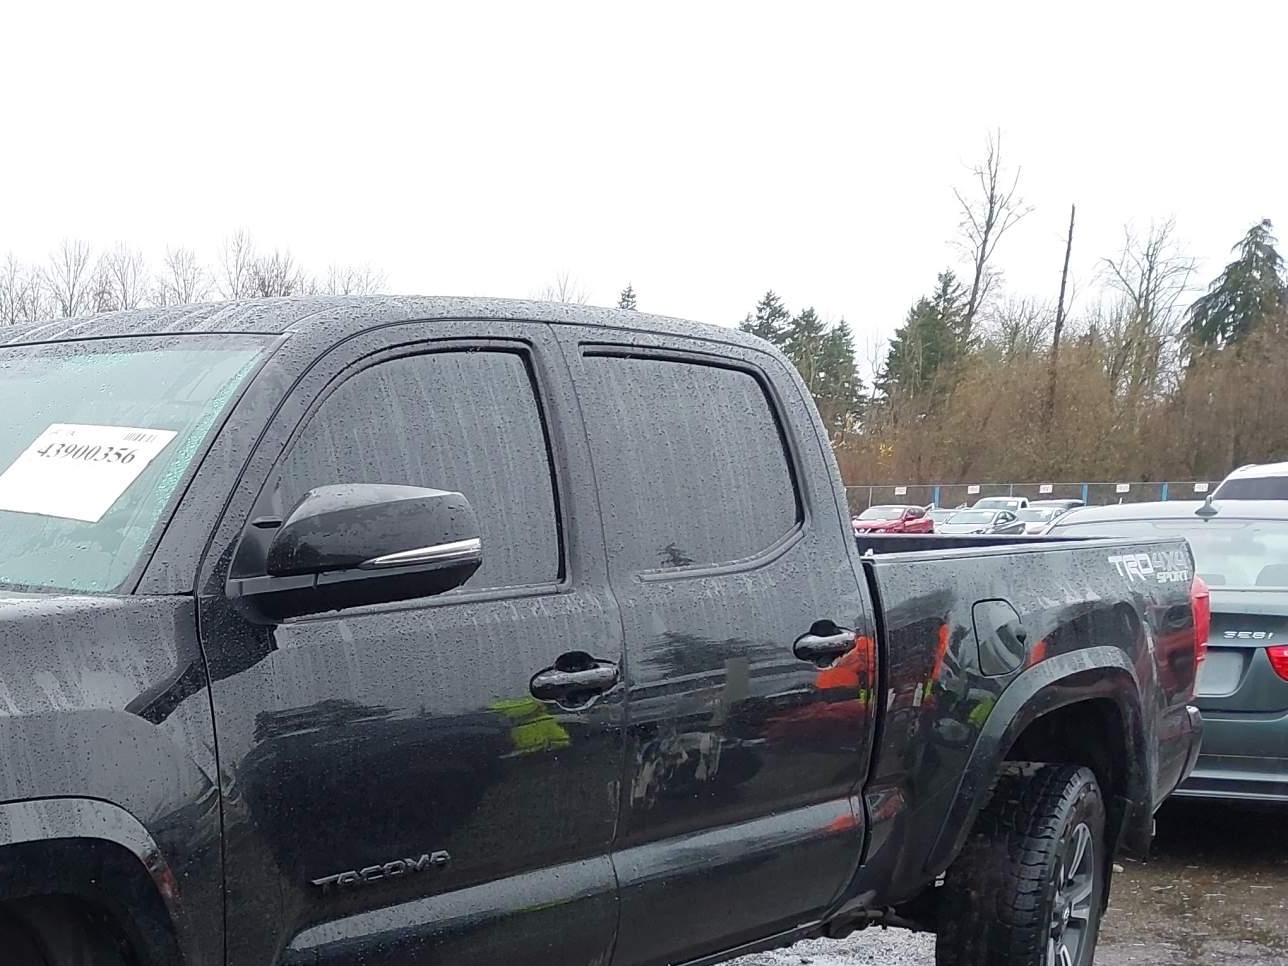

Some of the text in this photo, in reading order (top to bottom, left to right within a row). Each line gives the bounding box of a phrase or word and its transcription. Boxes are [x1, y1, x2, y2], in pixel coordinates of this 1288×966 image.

[37, 443, 138, 464] 43900356
[1108, 553, 1154, 582] TRD
[1156, 570, 1188, 583] SPORT
[311, 849, 451, 893] TACOMA
